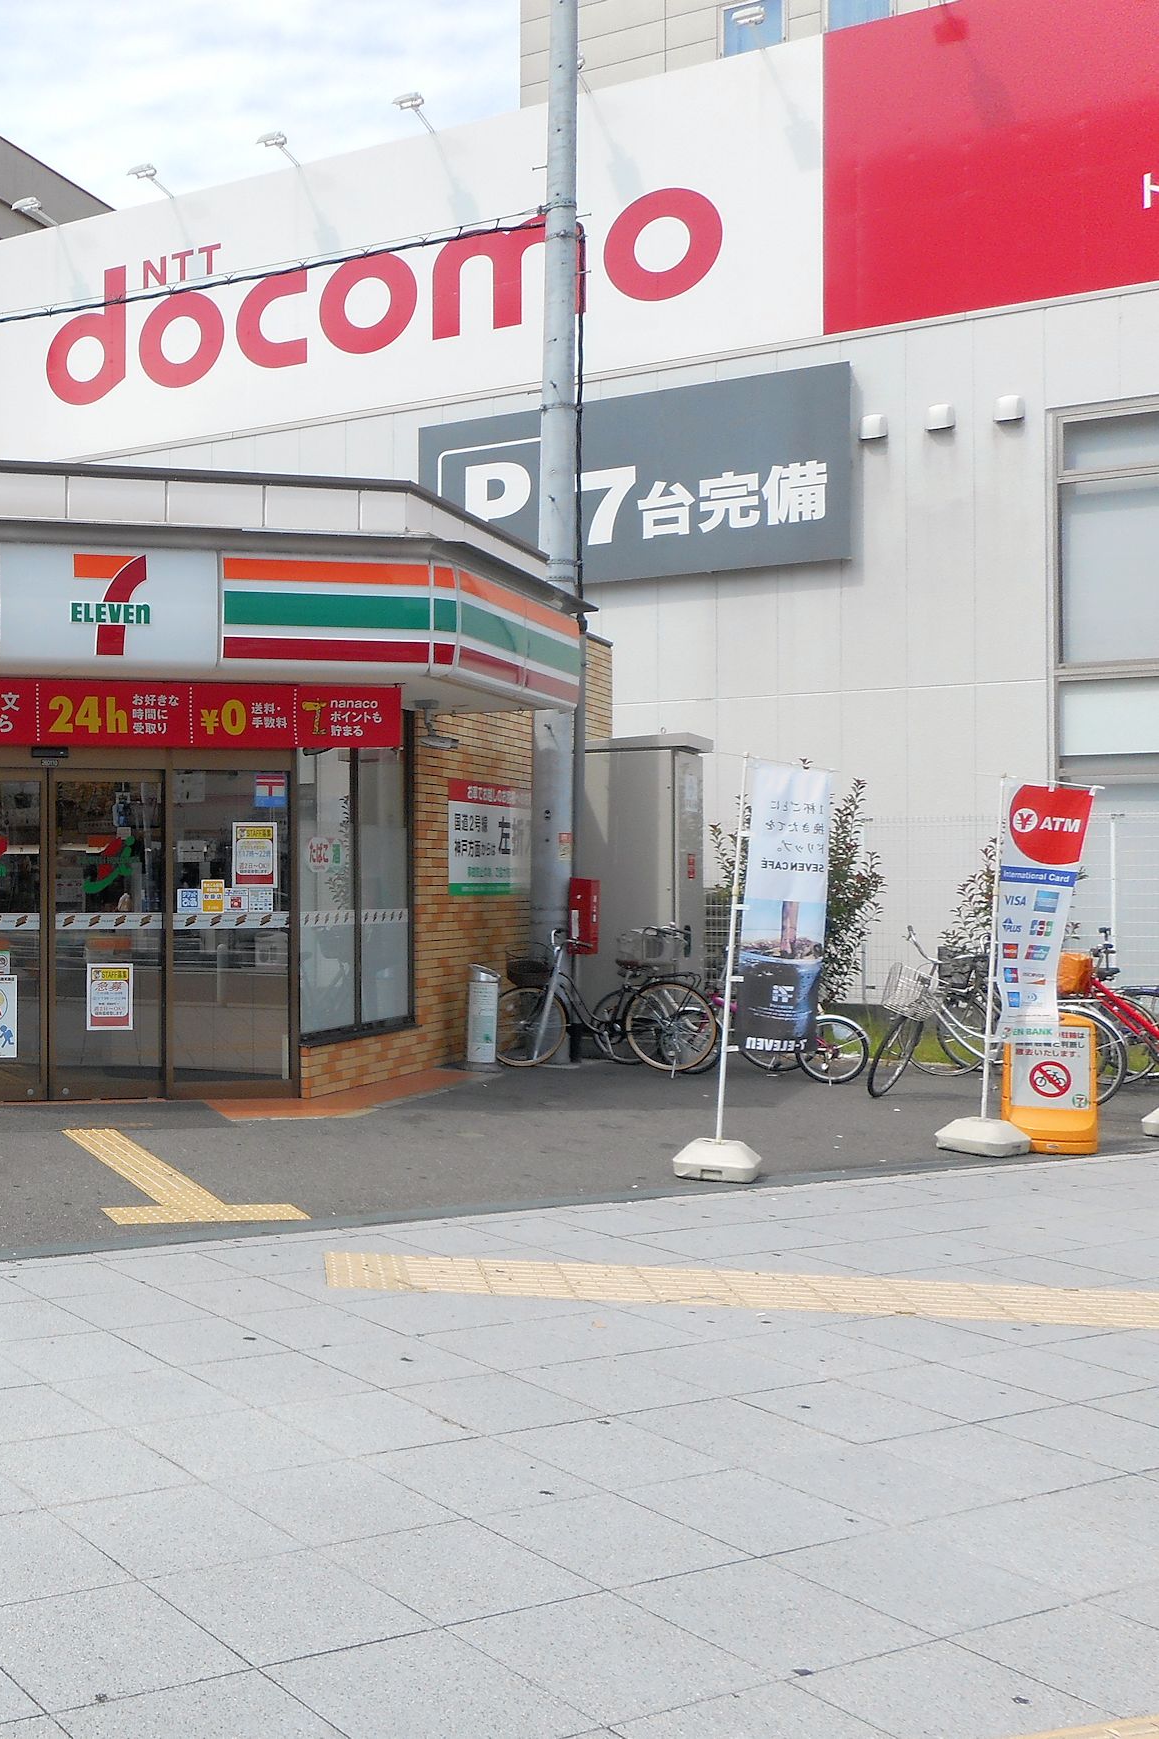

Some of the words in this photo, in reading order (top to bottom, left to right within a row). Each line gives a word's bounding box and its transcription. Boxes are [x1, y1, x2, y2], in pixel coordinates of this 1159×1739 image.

[143, 243, 221, 289] NTT
[46, 187, 723, 405] docomo
[132, 694, 179, 707] お好きな
[330, 699, 378, 709] nanaco
[48, 695, 128, 734] 24h
[132, 708, 168, 720] 時間に
[330, 712, 383, 723] ポイントも
[132, 723, 168, 734] 受取り
[252, 717, 288, 729] 手数料
[331, 725, 363, 737] 貯まる
[1040, 816, 1082, 833] ATM
[1003, 870, 1047, 880] International
[1048, 873, 1070, 883] Card
[1004, 895, 1027, 906] VISA
[1026, 1028, 1053, 1036] BANK
